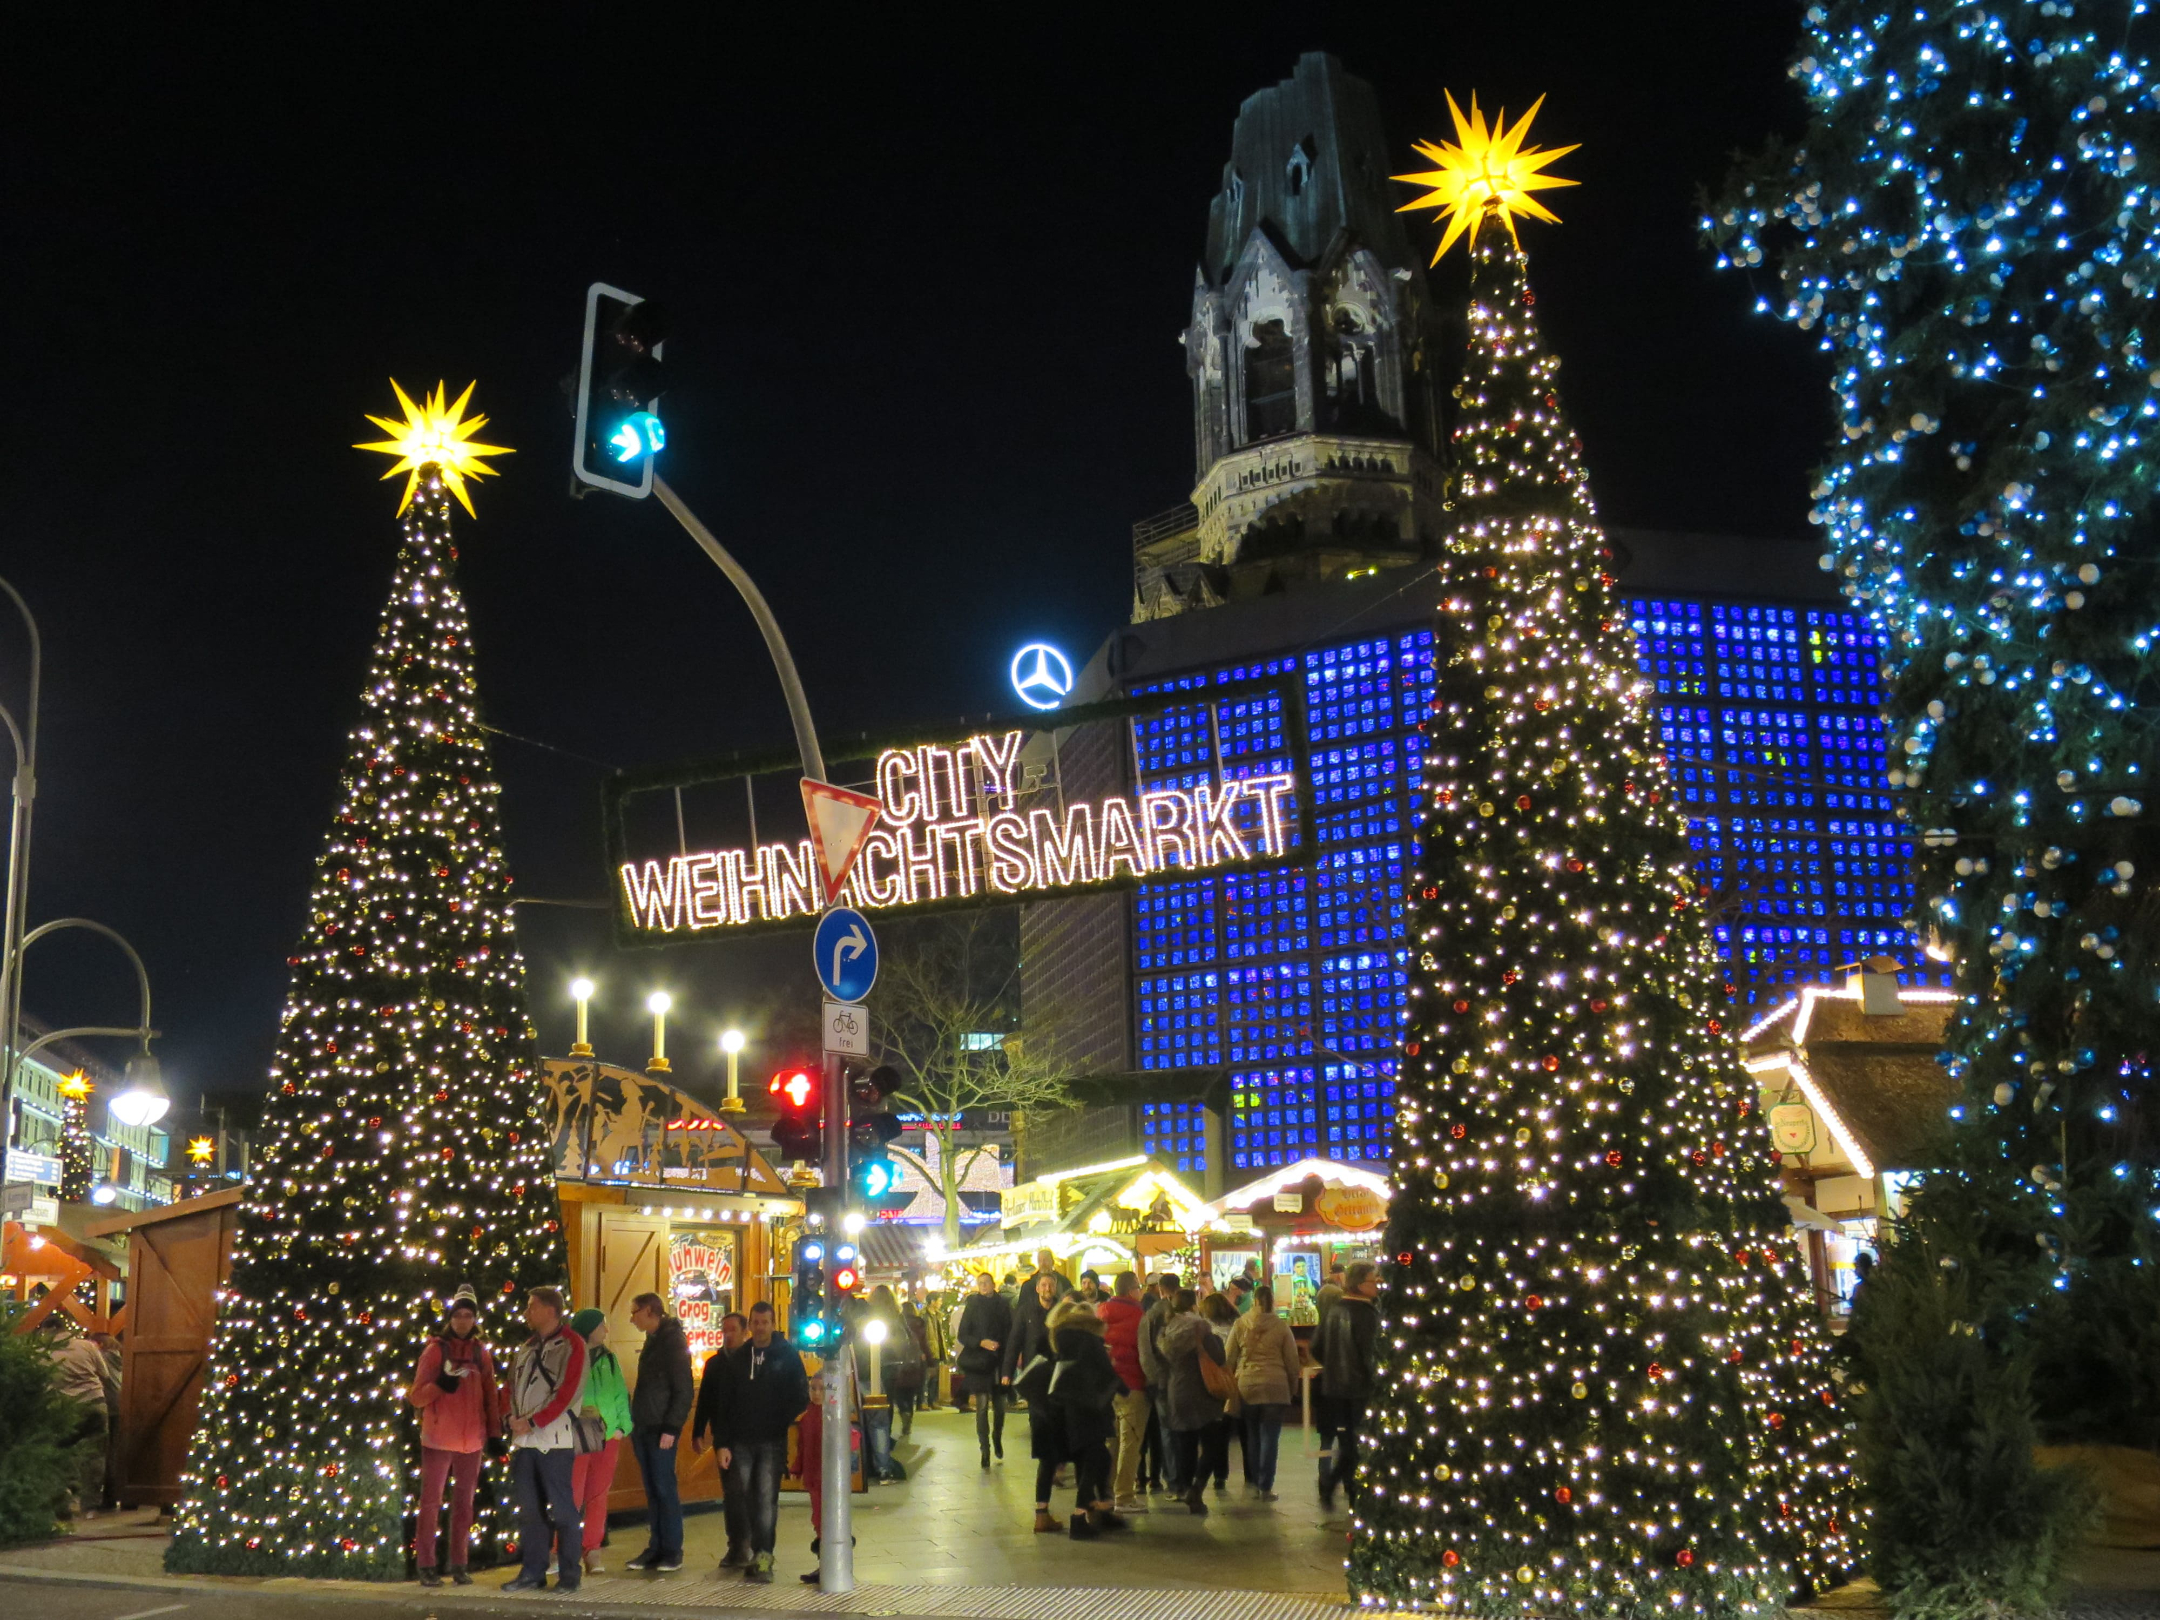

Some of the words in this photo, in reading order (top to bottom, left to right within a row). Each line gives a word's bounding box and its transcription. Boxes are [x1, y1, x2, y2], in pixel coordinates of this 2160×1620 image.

[875, 730, 1022, 827] CITY
[839, 1036, 854, 1049] frei
[668, 1242, 732, 1285] lühwein
[678, 1299, 710, 1322] Grog
